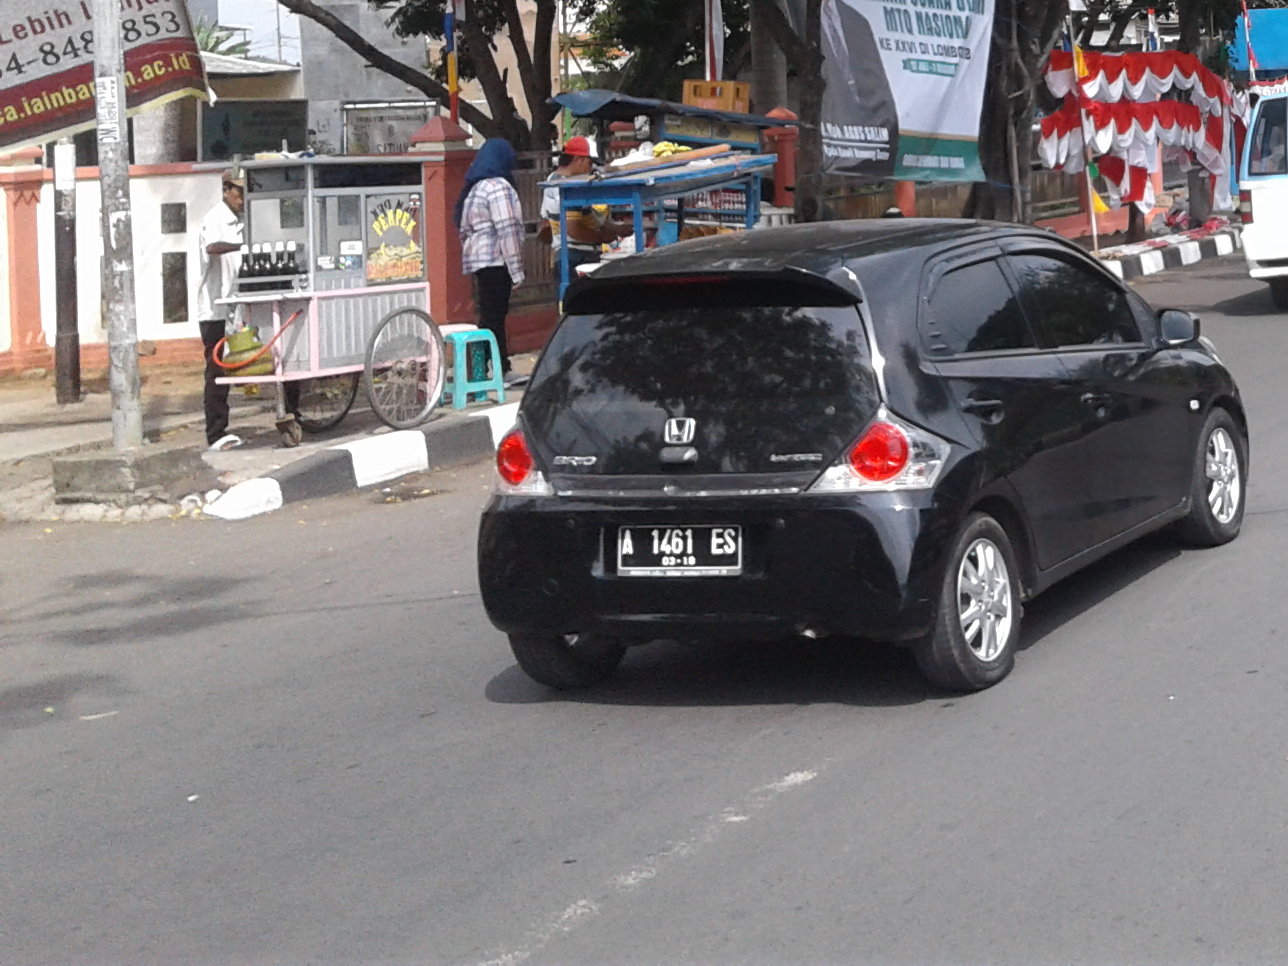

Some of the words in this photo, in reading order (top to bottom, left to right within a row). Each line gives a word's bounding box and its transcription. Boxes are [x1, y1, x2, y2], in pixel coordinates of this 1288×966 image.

[883, 6, 914, 35] MTQ
[879, 37, 892, 51] KE
[372, 209, 416, 237] PEMPEK
[622, 529, 633, 555] A
[652, 529, 693, 555] 1461
[711, 528, 736, 555] ES
